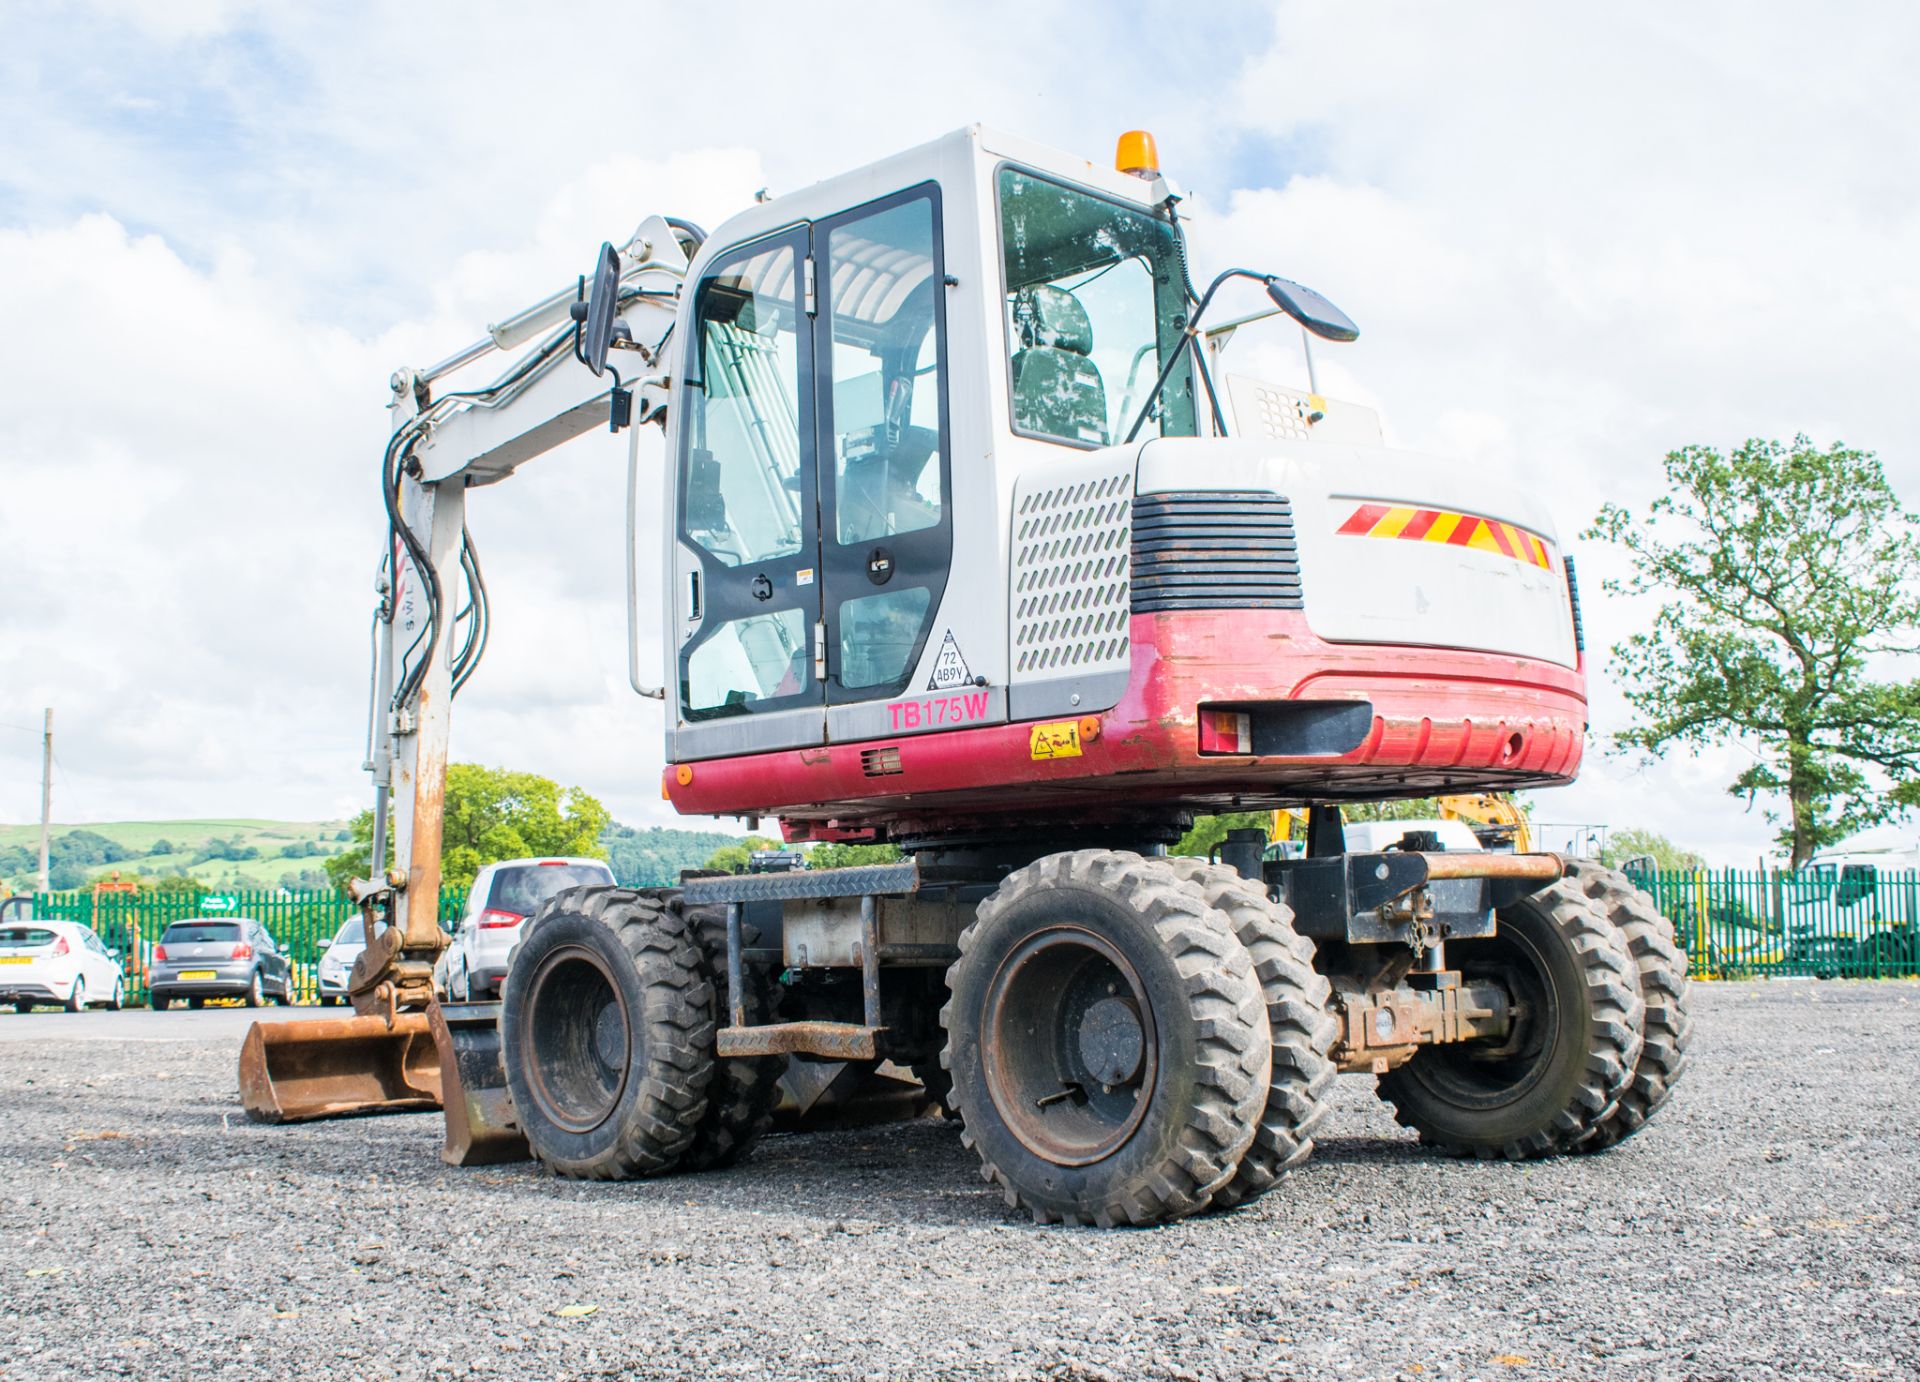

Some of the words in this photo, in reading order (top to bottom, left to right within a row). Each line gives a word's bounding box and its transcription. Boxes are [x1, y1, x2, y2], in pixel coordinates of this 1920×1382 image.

[943, 651, 956, 665] 72
[937, 666, 963, 682] AB9Y
[887, 691, 989, 730] TB175W
